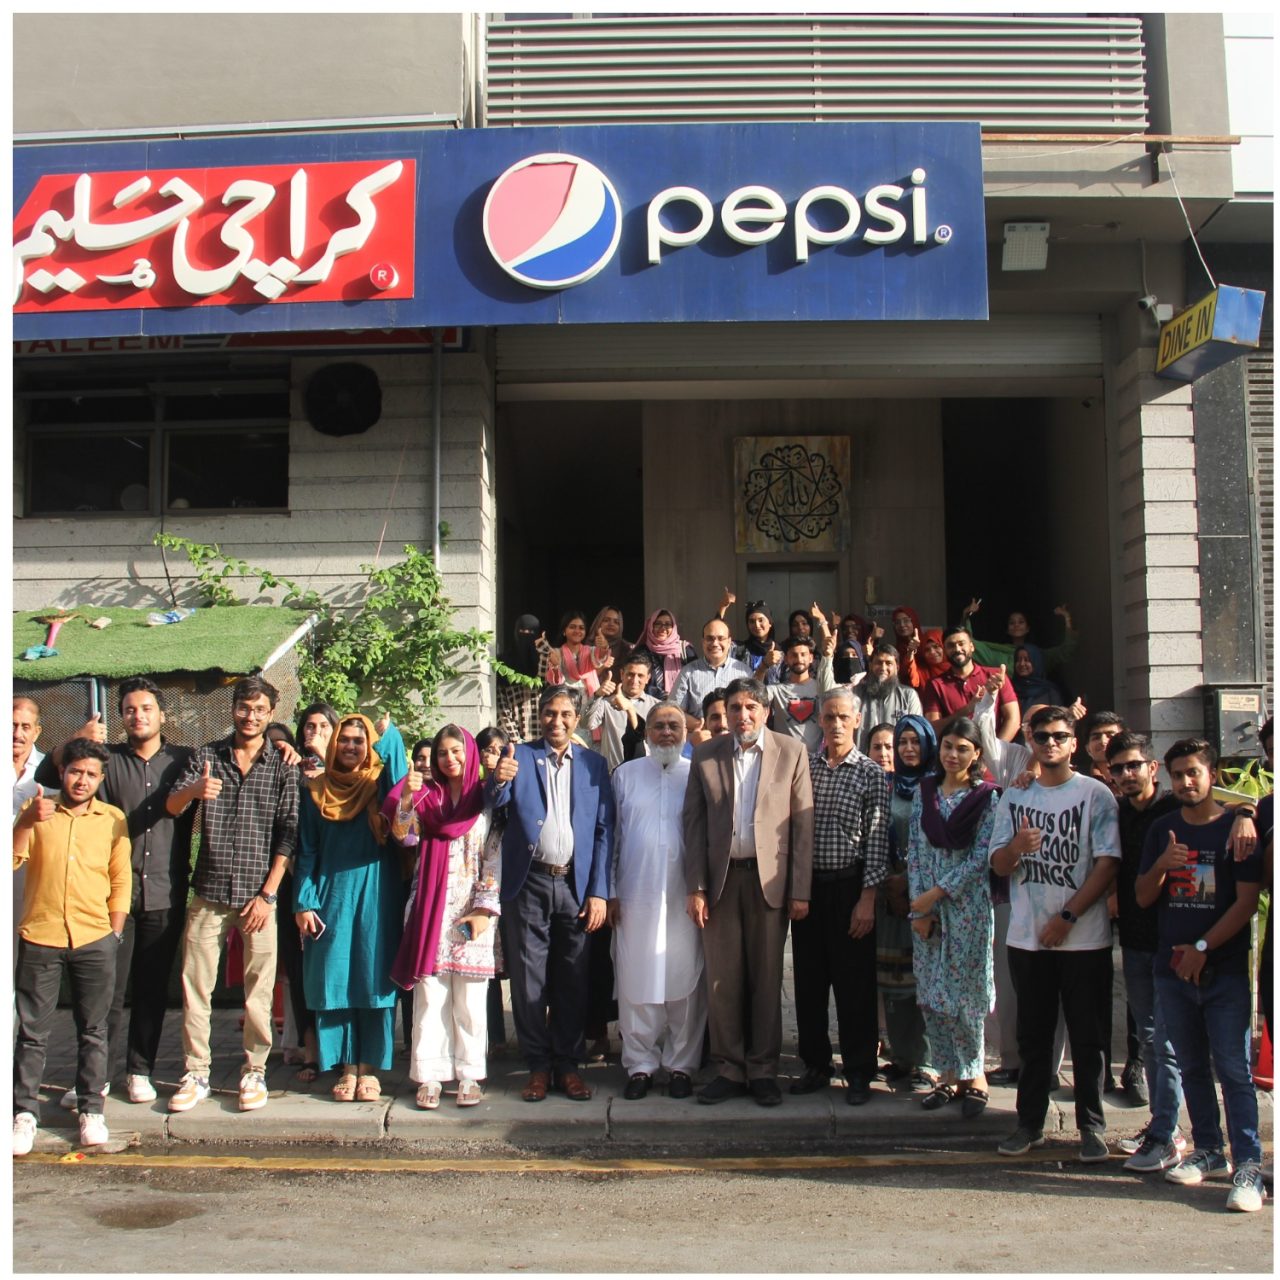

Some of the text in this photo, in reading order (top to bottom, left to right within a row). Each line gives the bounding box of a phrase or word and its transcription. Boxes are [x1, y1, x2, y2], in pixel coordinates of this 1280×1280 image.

[647, 167, 927, 265] pepsi
[1161, 302, 1213, 364] DINE IN
[1040, 834, 1080, 864] GOOD
[1059, 800, 1085, 845] ON
